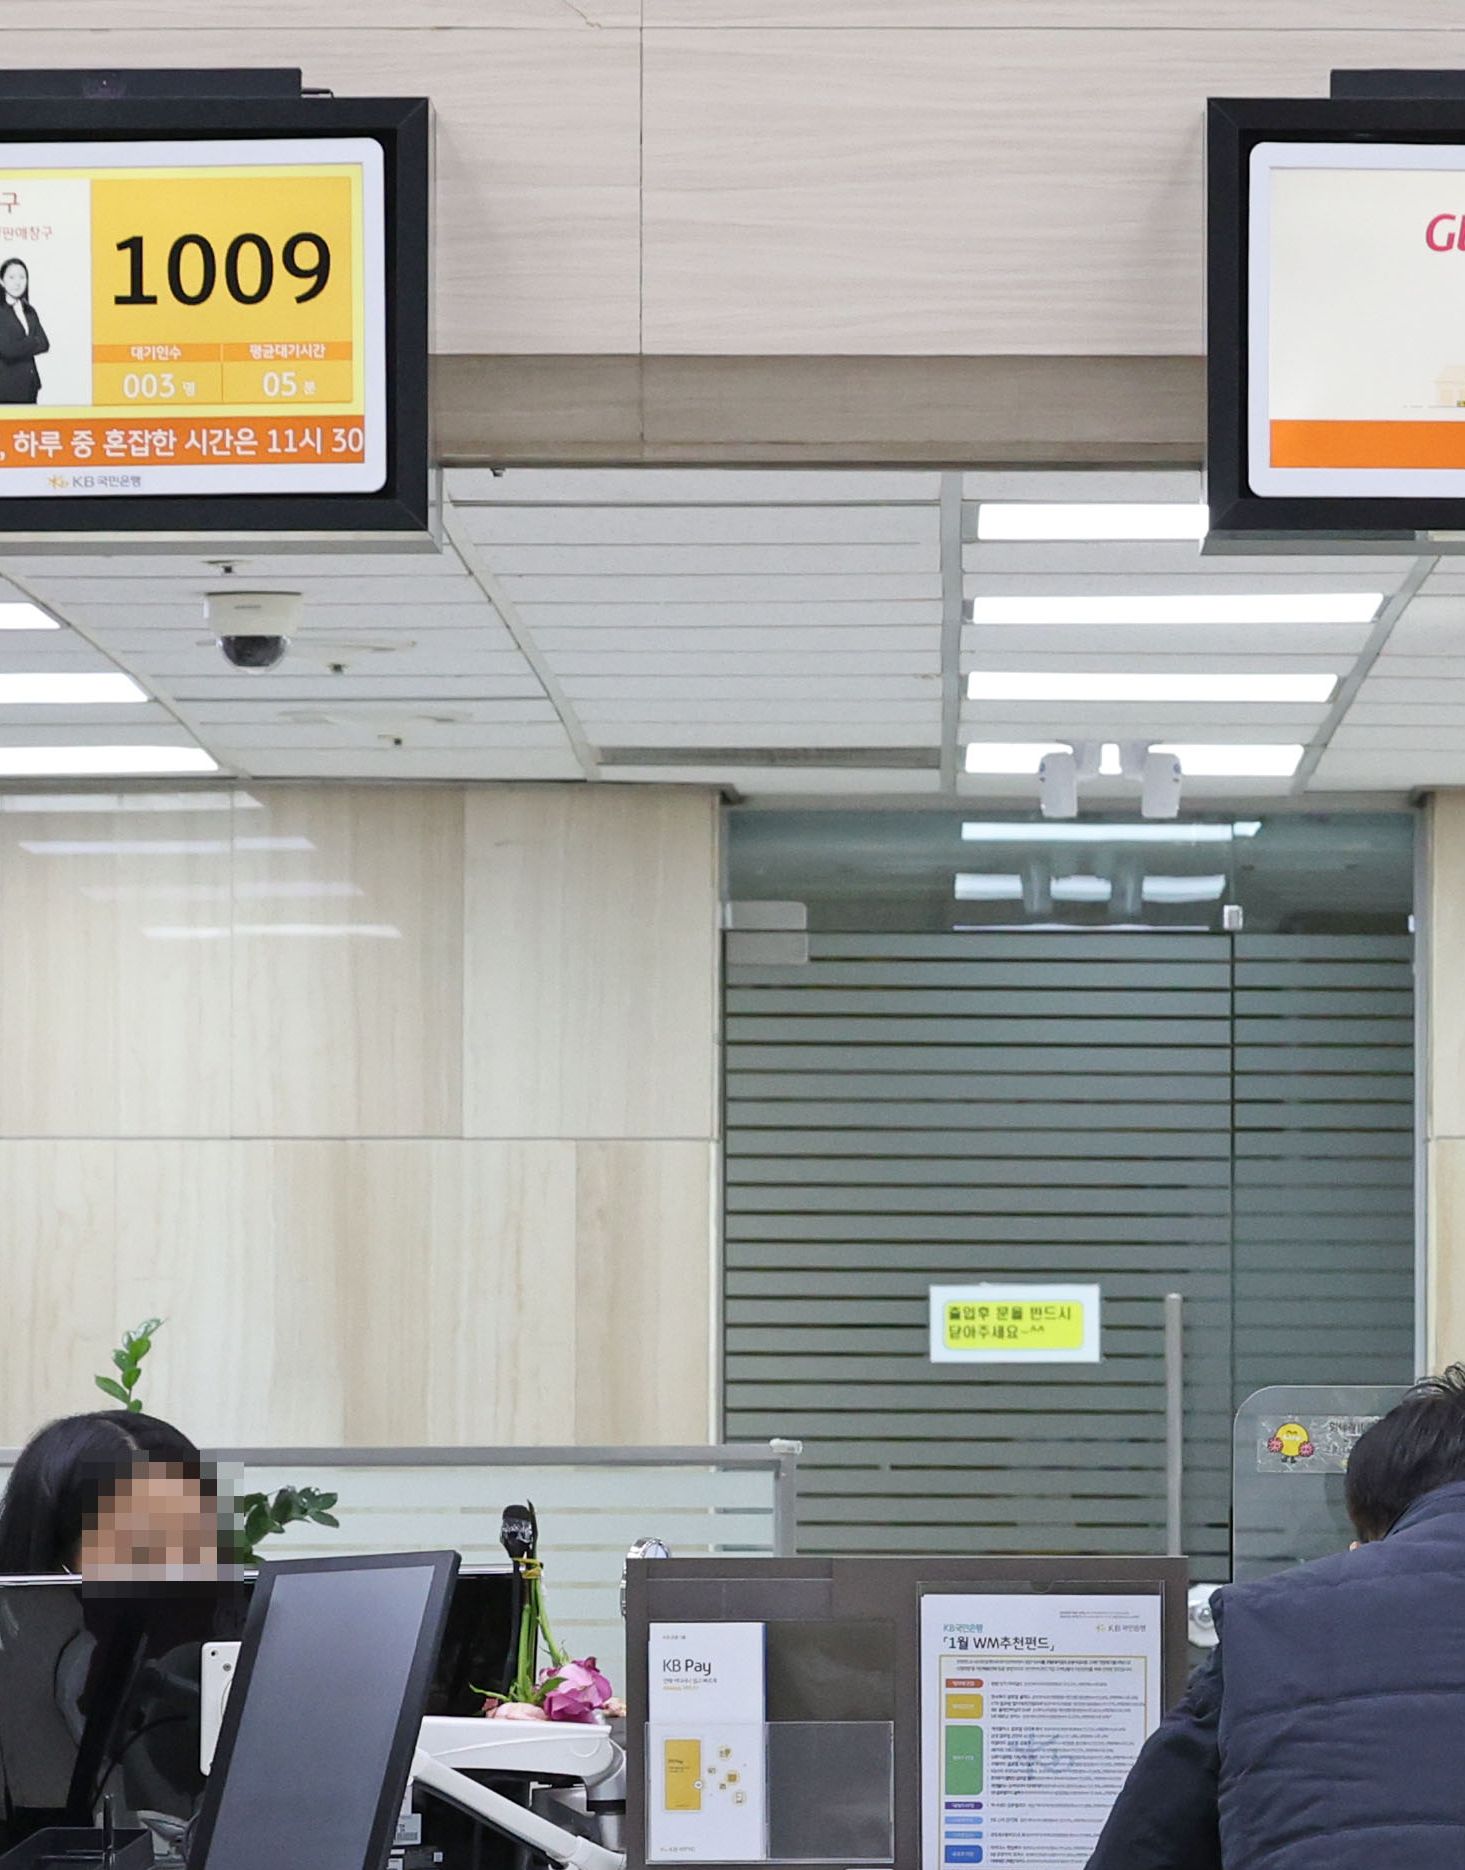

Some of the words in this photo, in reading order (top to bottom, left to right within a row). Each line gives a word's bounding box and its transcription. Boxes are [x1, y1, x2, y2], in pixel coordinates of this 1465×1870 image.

[113, 231, 332, 307] 1009
[131, 345, 182, 360] 대기인수
[249, 343, 327, 359] 평균대기시간
[123, 372, 175, 398] 003
[262, 371, 298, 397] 05
[13, 429, 64, 459] 하루
[71, 430, 94, 459] 중
[101, 427, 177, 458] 혼잡한
[185, 425, 259, 457] 시간은
[265, 425, 324, 456] 11시
[331, 424, 365, 455] 30
[72, 476, 94, 489] KB
[96, 474, 141, 489] 국민은행
[662, 1659, 682, 1673] KB
[685, 1659, 712, 1676] Pay
